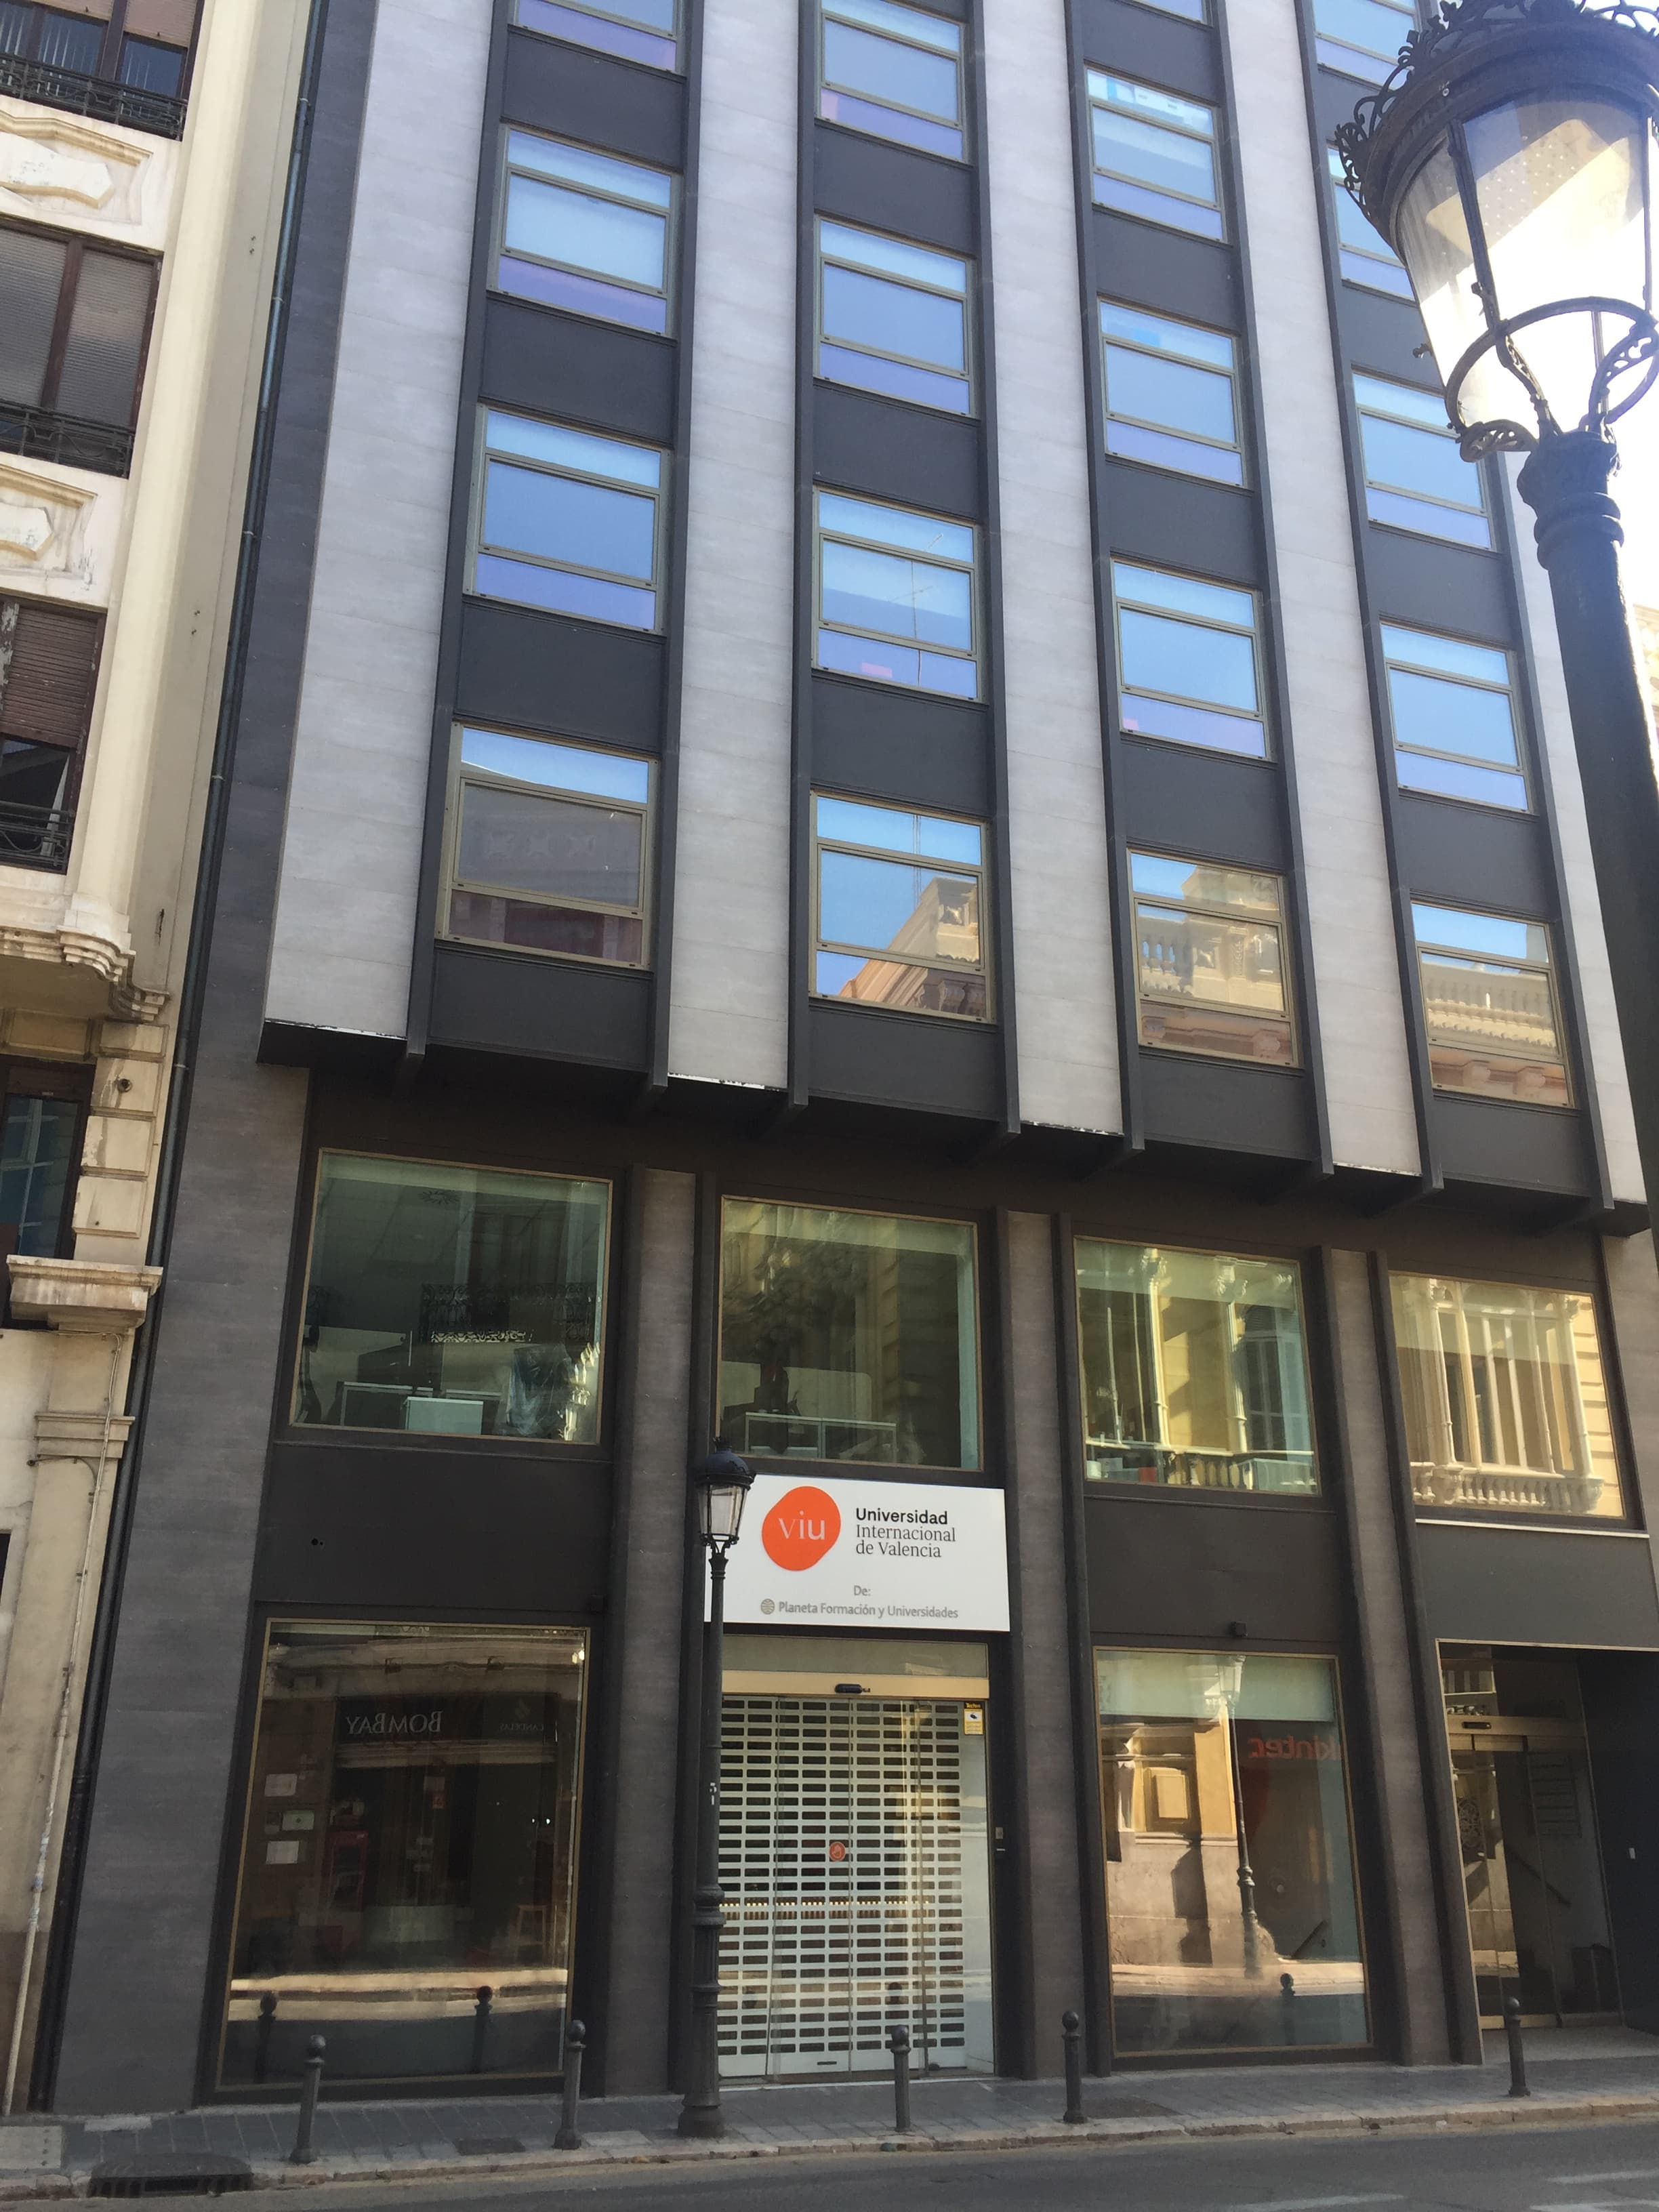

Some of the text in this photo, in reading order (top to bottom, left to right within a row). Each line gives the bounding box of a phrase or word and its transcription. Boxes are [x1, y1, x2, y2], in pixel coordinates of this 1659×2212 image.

[855, 1507, 948, 1525] Universidad
[779, 1511, 825, 1540] viu
[856, 1524, 956, 1542] Internacional
[855, 1540, 942, 1558] de Valencia
[853, 1585, 872, 1596] De:
[779, 1601, 959, 1618] Planeta Formación y Universidades
